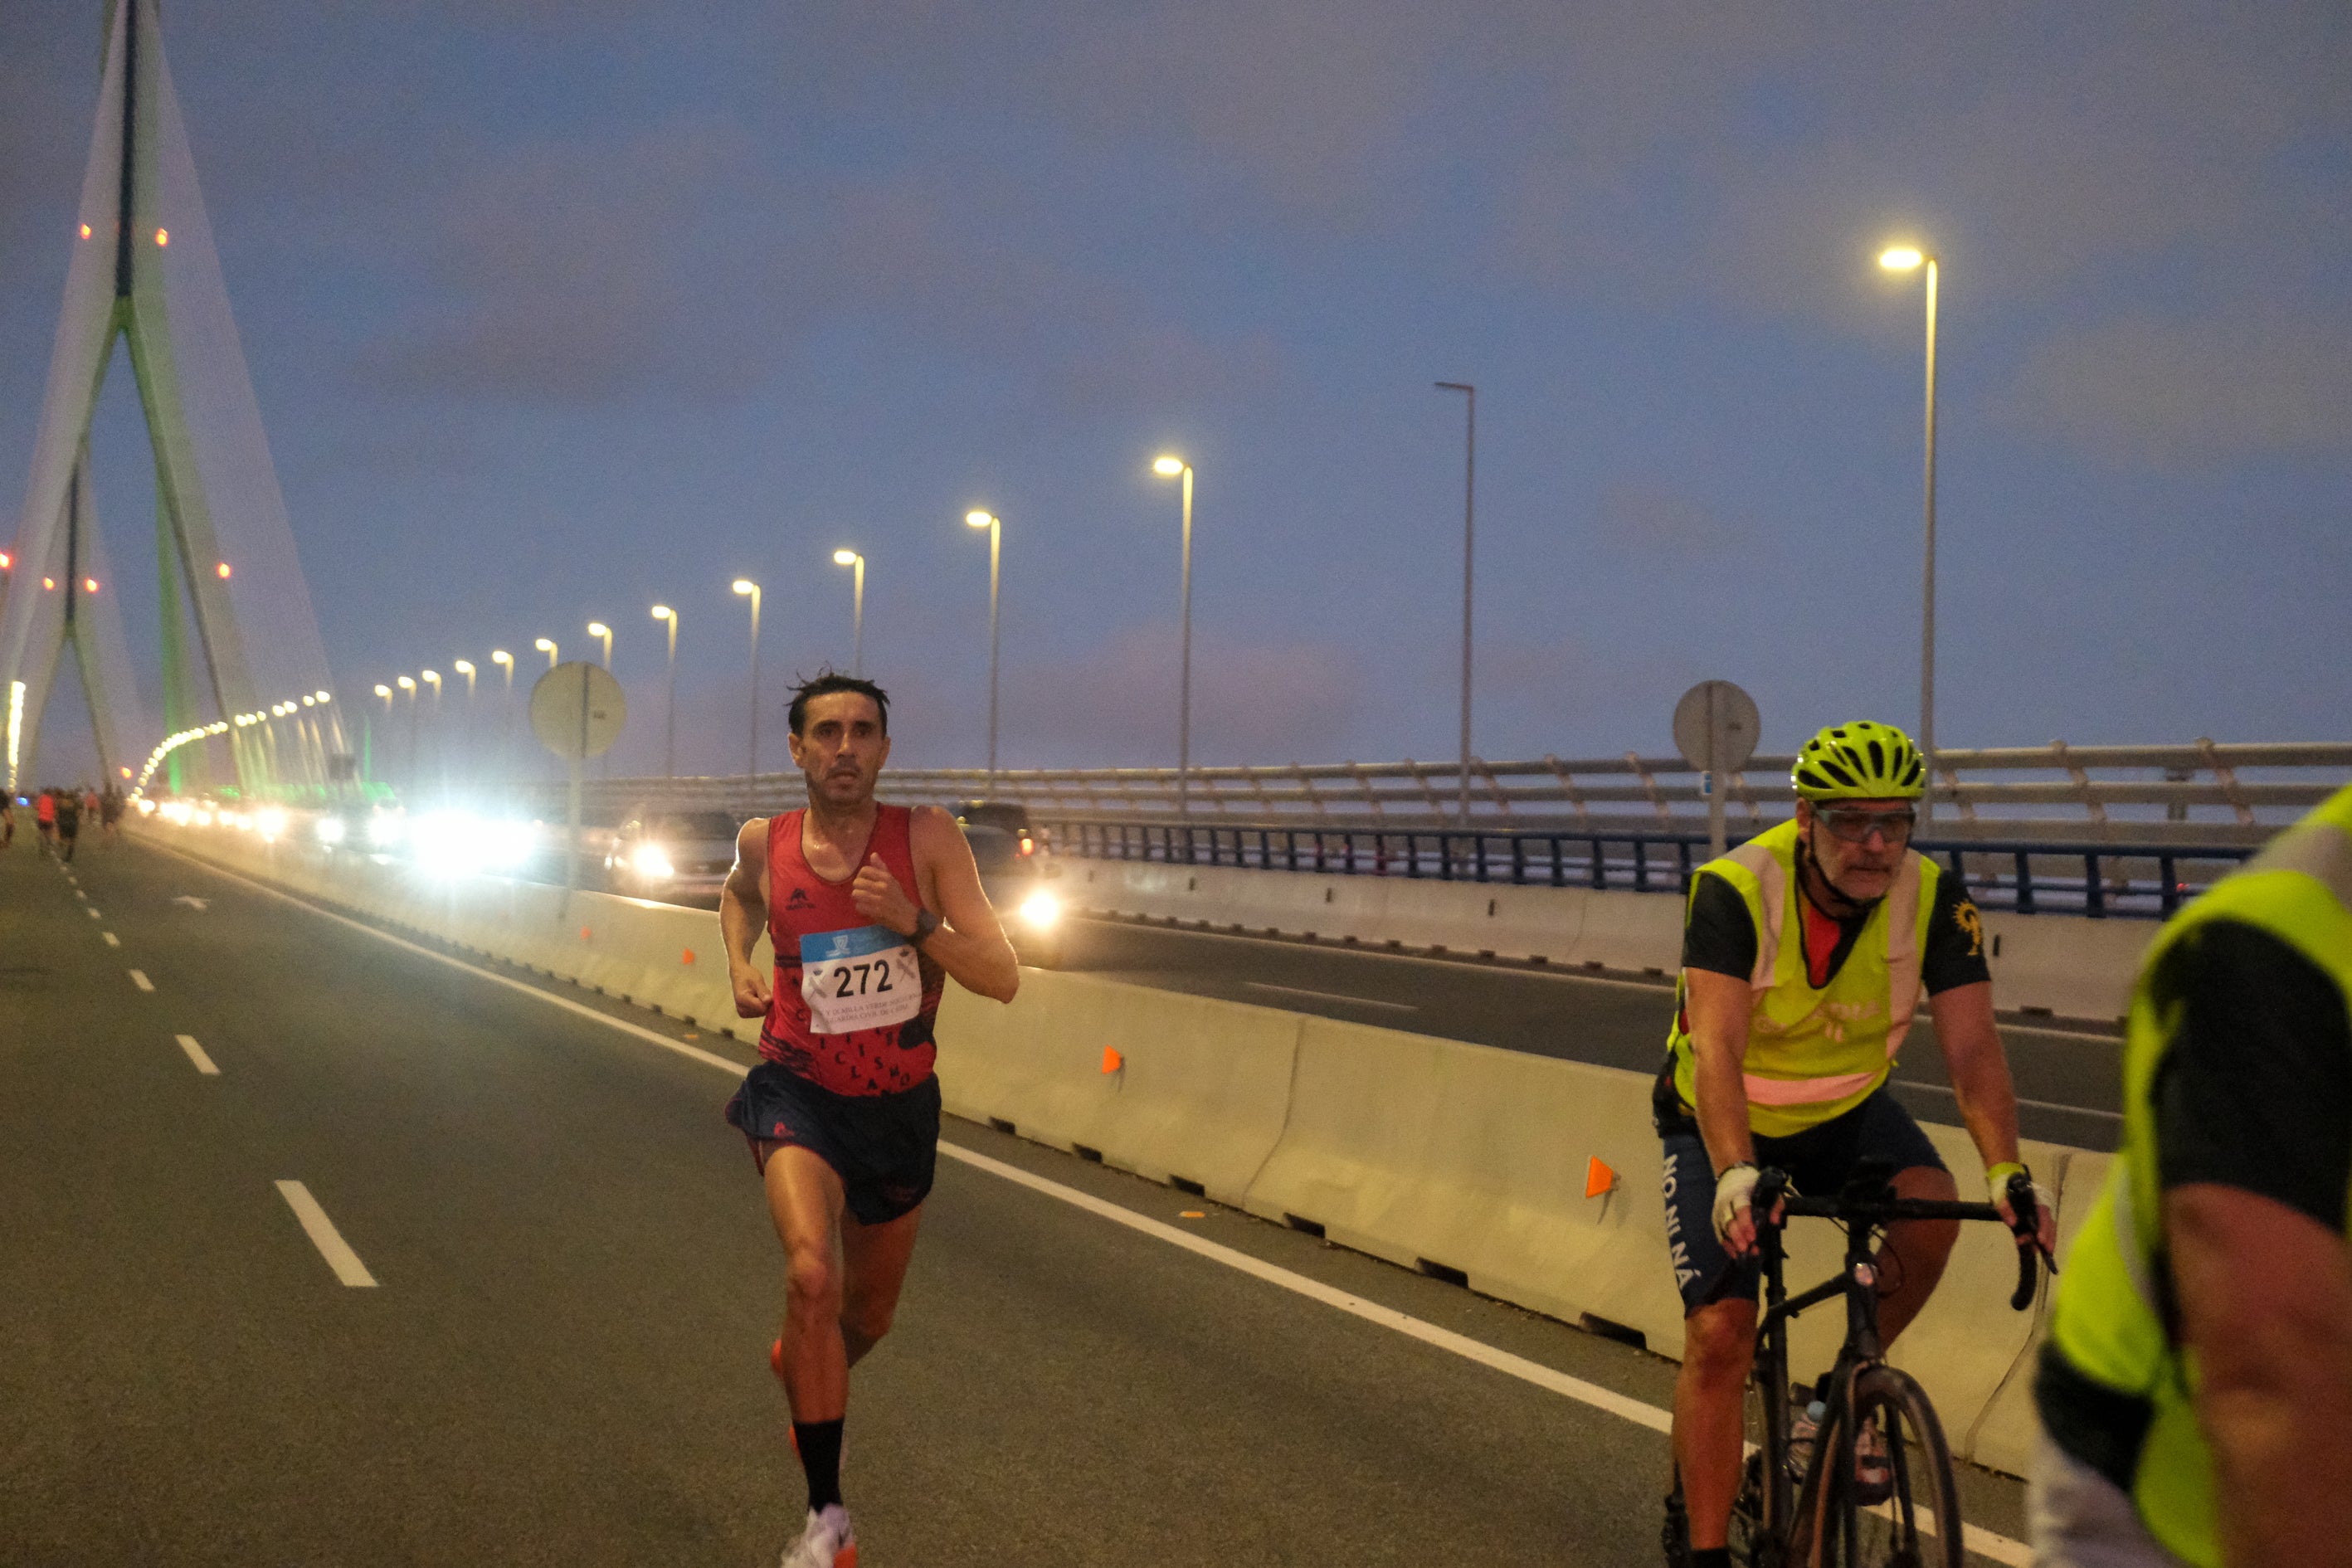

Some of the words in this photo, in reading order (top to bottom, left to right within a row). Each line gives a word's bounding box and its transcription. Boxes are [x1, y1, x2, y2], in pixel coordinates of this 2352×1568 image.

[834, 959, 893, 998] 272
[1663, 1153, 1678, 1199] NO
[1666, 1205, 1682, 1237] NI
[1672, 1241, 1702, 1290] NÁ
